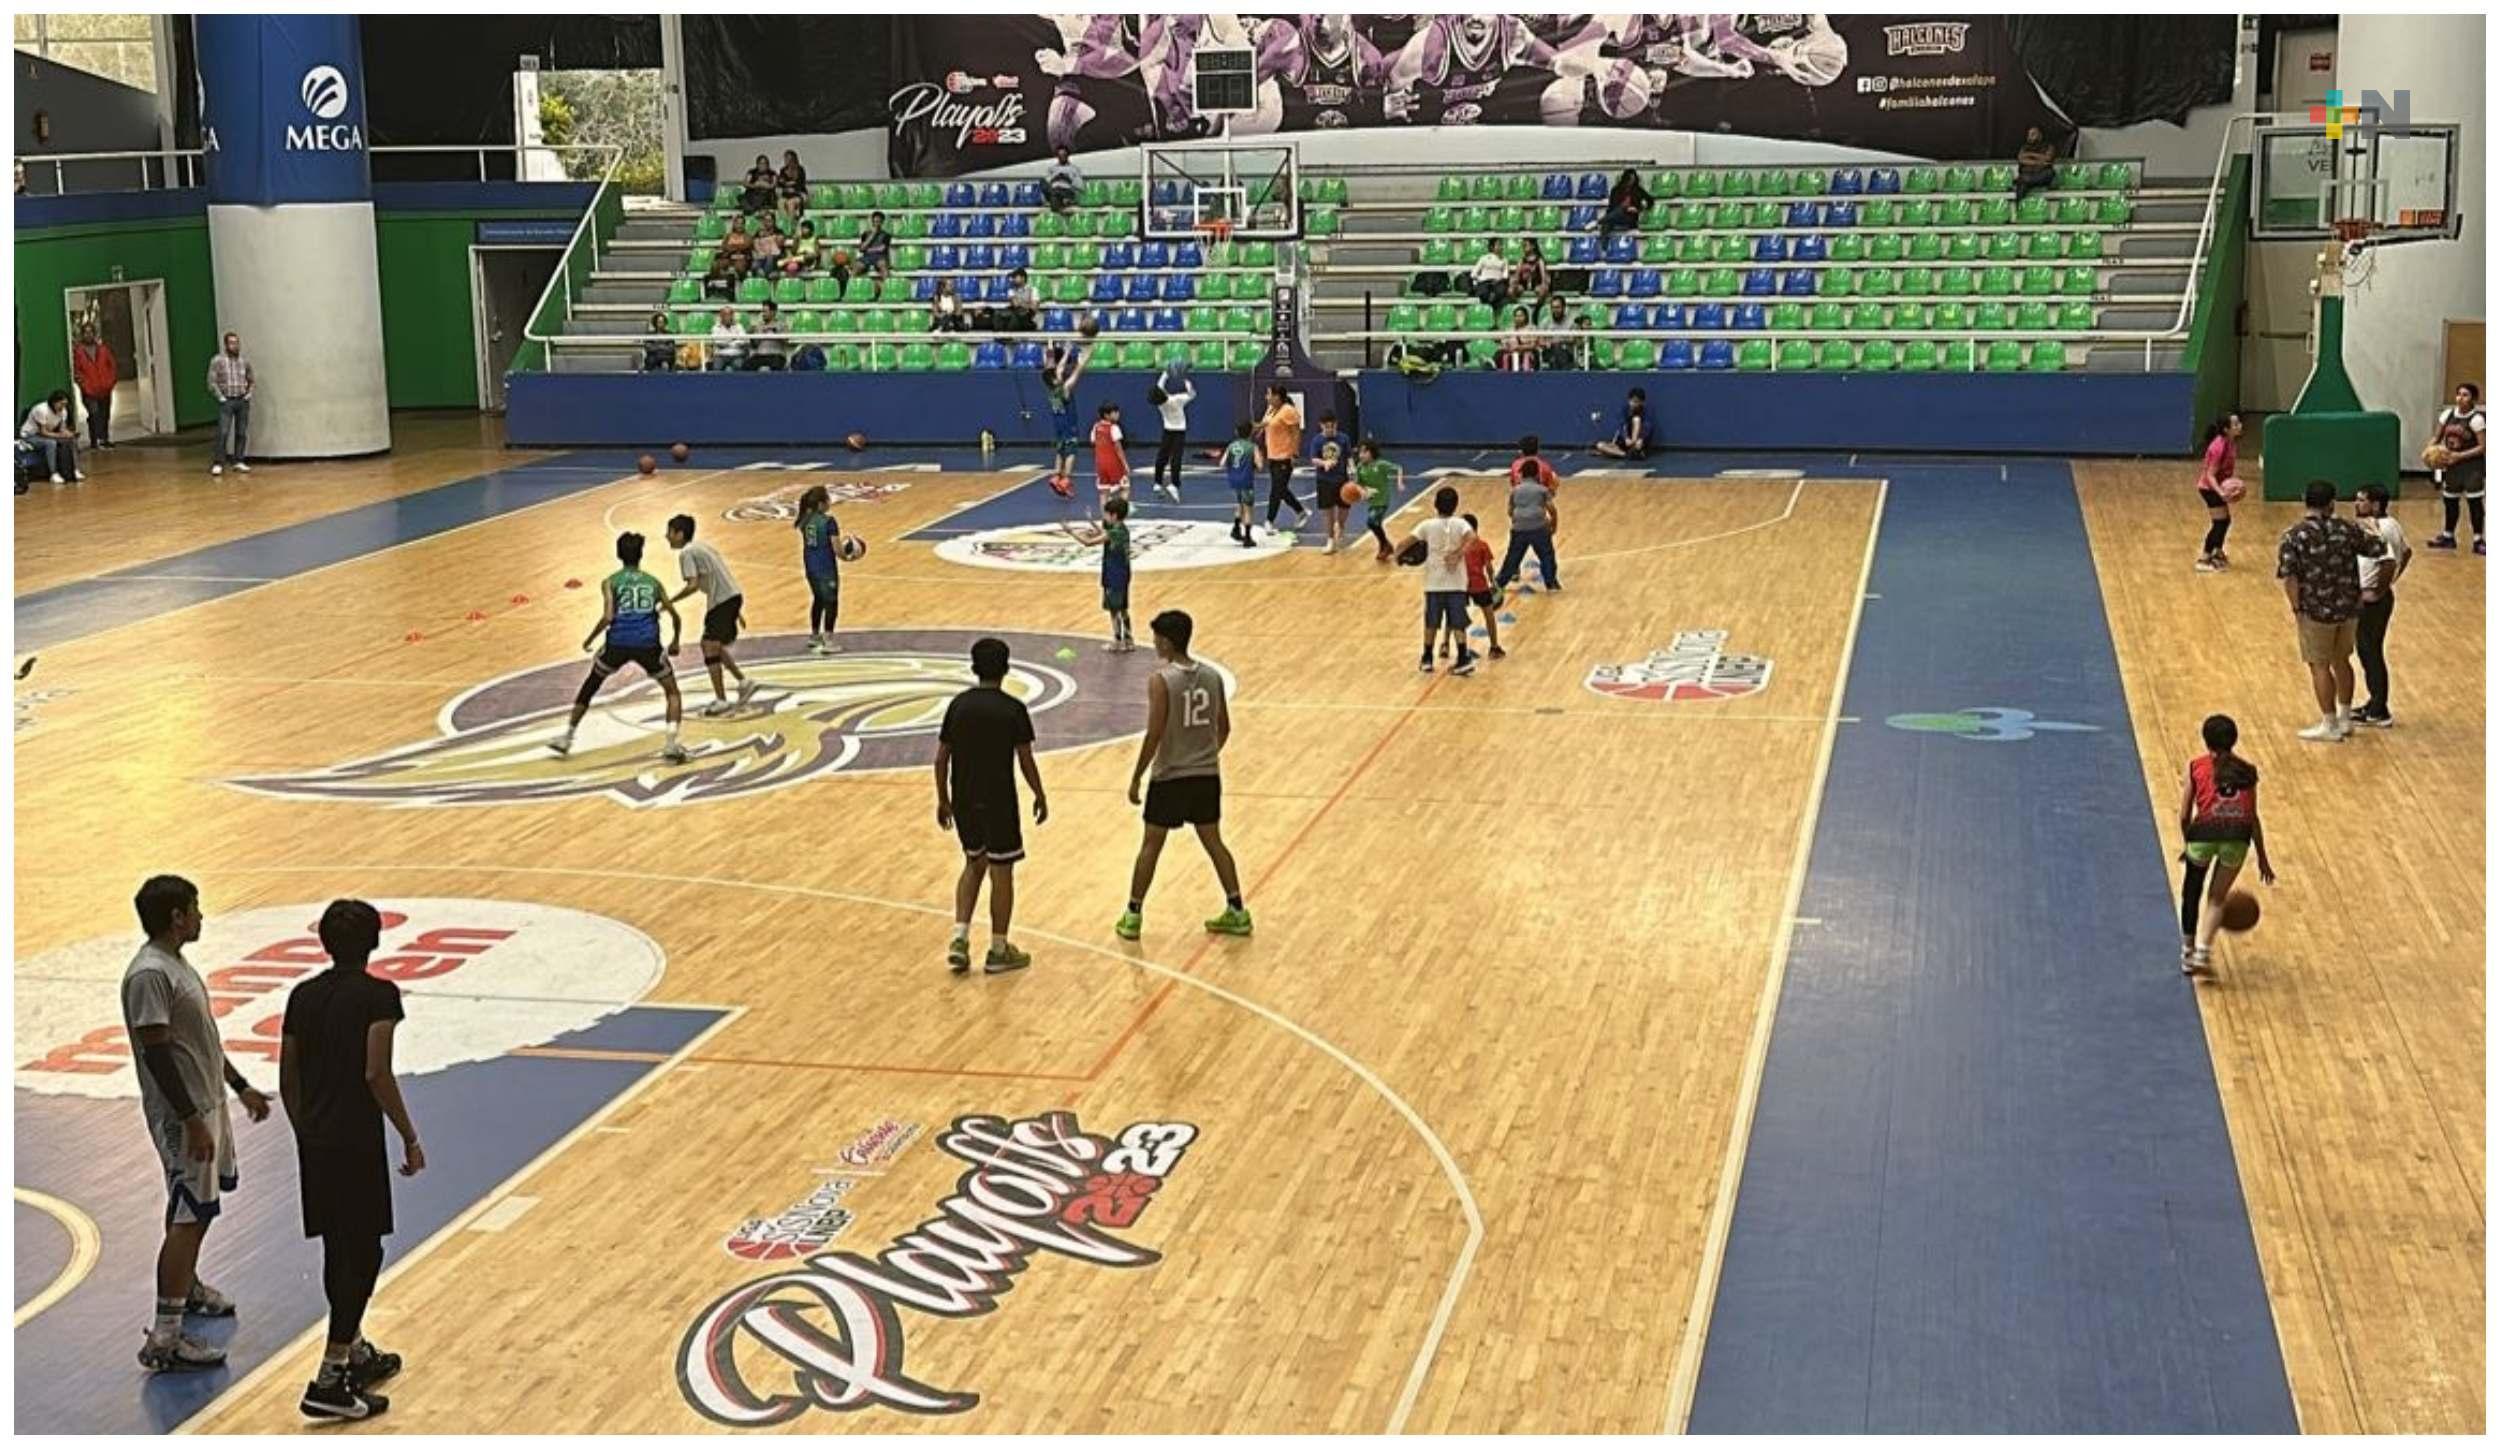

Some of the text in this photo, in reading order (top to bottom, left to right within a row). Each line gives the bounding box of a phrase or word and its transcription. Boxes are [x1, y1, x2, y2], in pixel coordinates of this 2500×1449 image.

[1885, 23, 1967, 54] HALCONES
[889, 82, 1027, 149] Playoffs
[286, 125, 362, 151] MEGA
[1183, 687, 1210, 728] 12
[676, 1110, 1163, 1428] Playoffs
